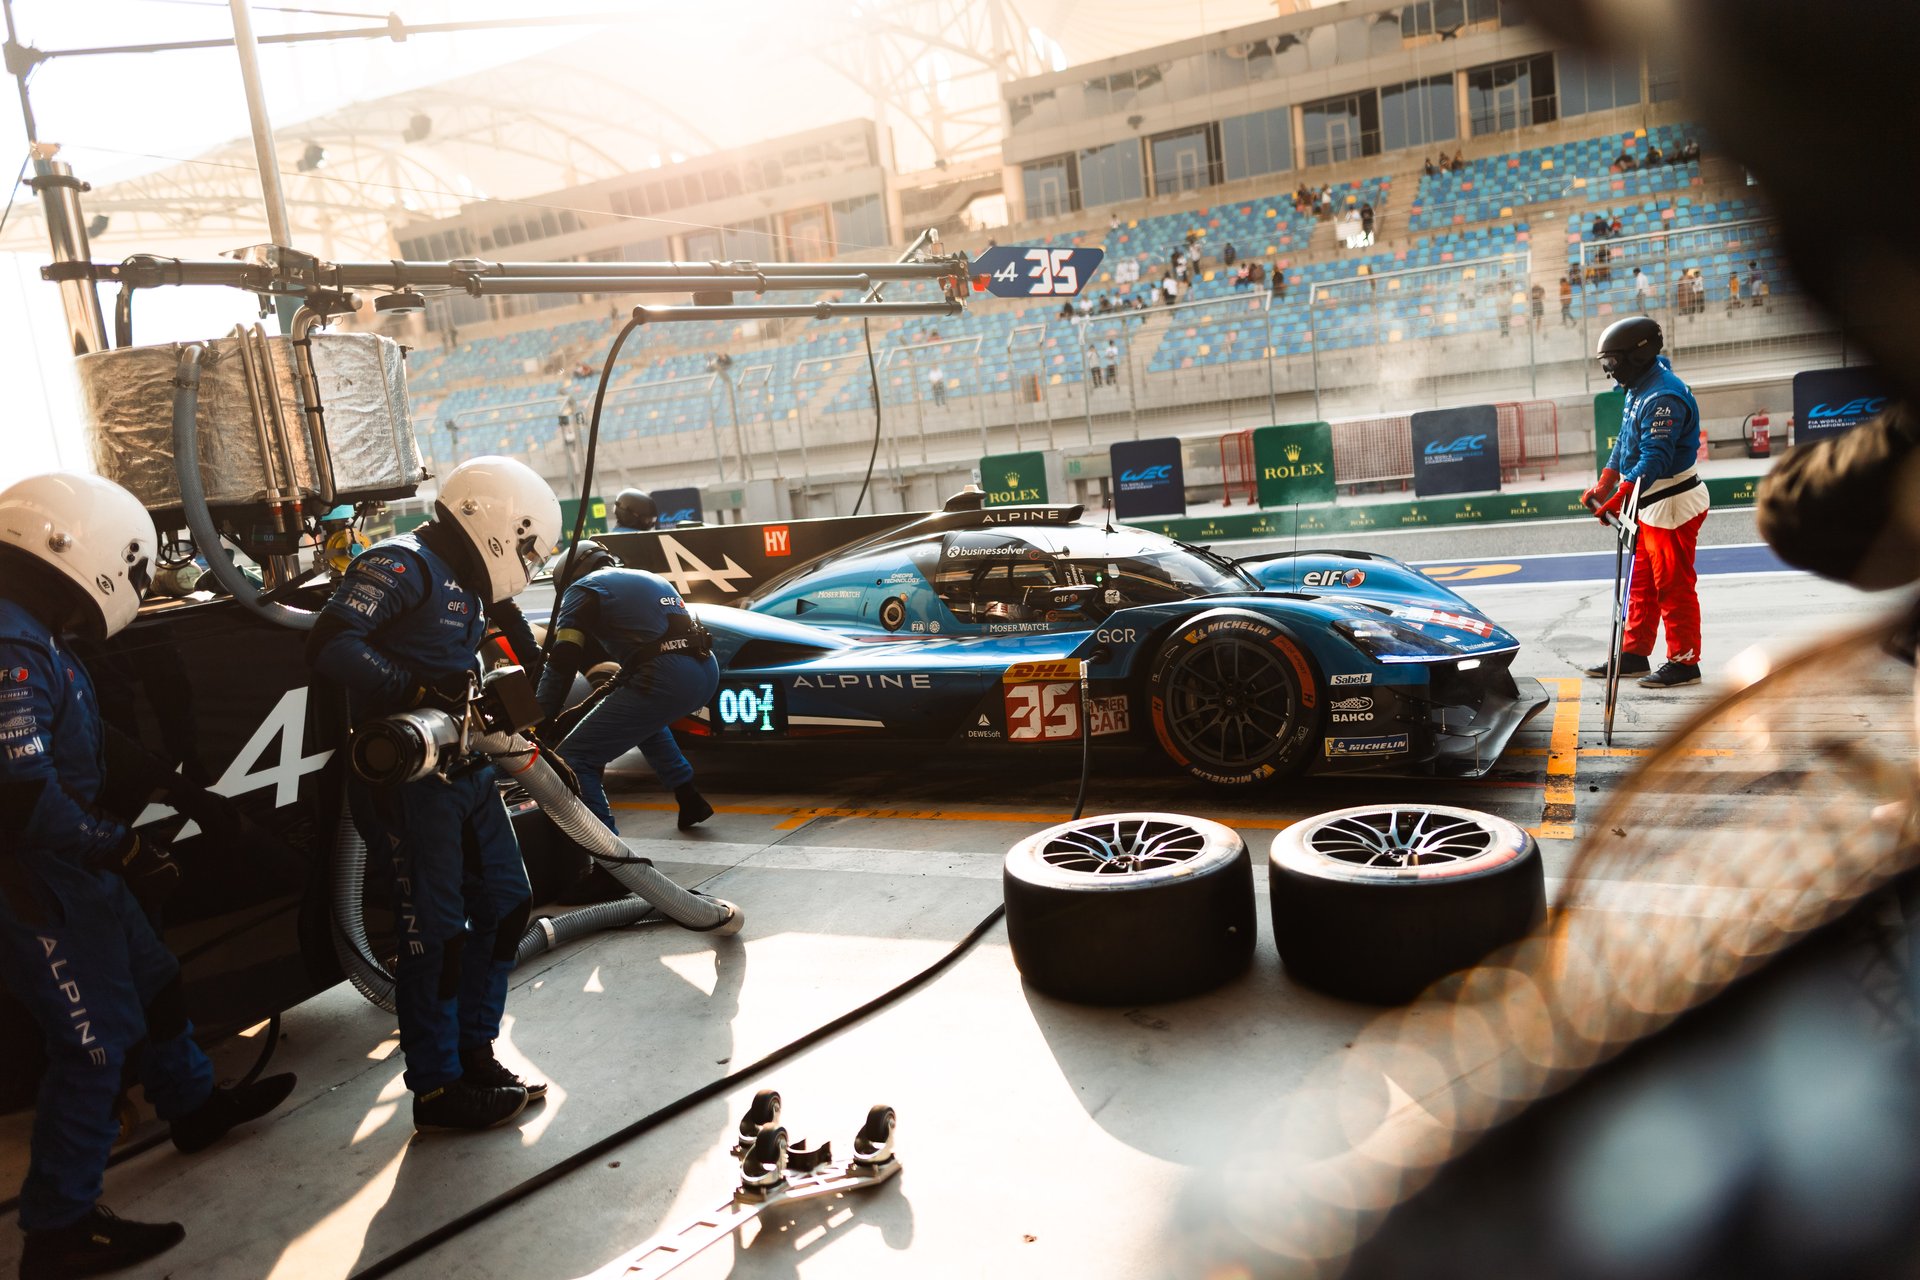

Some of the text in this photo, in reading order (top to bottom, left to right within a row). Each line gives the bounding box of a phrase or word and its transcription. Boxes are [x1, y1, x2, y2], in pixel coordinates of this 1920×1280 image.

[1024, 249, 1079, 294] 35
[1808, 397, 1888, 418] WEC
[1424, 433, 1487, 455] WEC
[1121, 464, 1173, 481] WEC
[1265, 462, 1325, 480] ROLEX
[989, 489, 1040, 504] ROLEX
[982, 510, 1059, 523] ALPINE
[1402, 515, 1428, 523] ROLEX
[764, 530, 788, 552] HY
[961, 545, 1027, 556] businessolver
[369, 557, 394, 568] elf
[1303, 570, 1342, 586] elf
[448, 601, 460, 611] elf
[660, 597, 676, 605] elf
[911, 623, 925, 631] FIA
[1208, 620, 1271, 636] MICHELIN
[1097, 628, 1136, 644] GCR
[660, 639, 688, 652] MRTC
[1013, 664, 1070, 677] DHL
[793, 674, 931, 688] ALPINE
[1335, 675, 1368, 684] Sabelt
[1006, 683, 1077, 739] 35
[1332, 713, 1374, 722] BAHCO
[1090, 711, 1128, 734] CAR
[1349, 741, 1406, 751] MICHELIN
[1191, 767, 1252, 784] MICHELIN
[387, 832, 424, 955] ALPINE
[36, 935, 107, 1066] ALPINE
